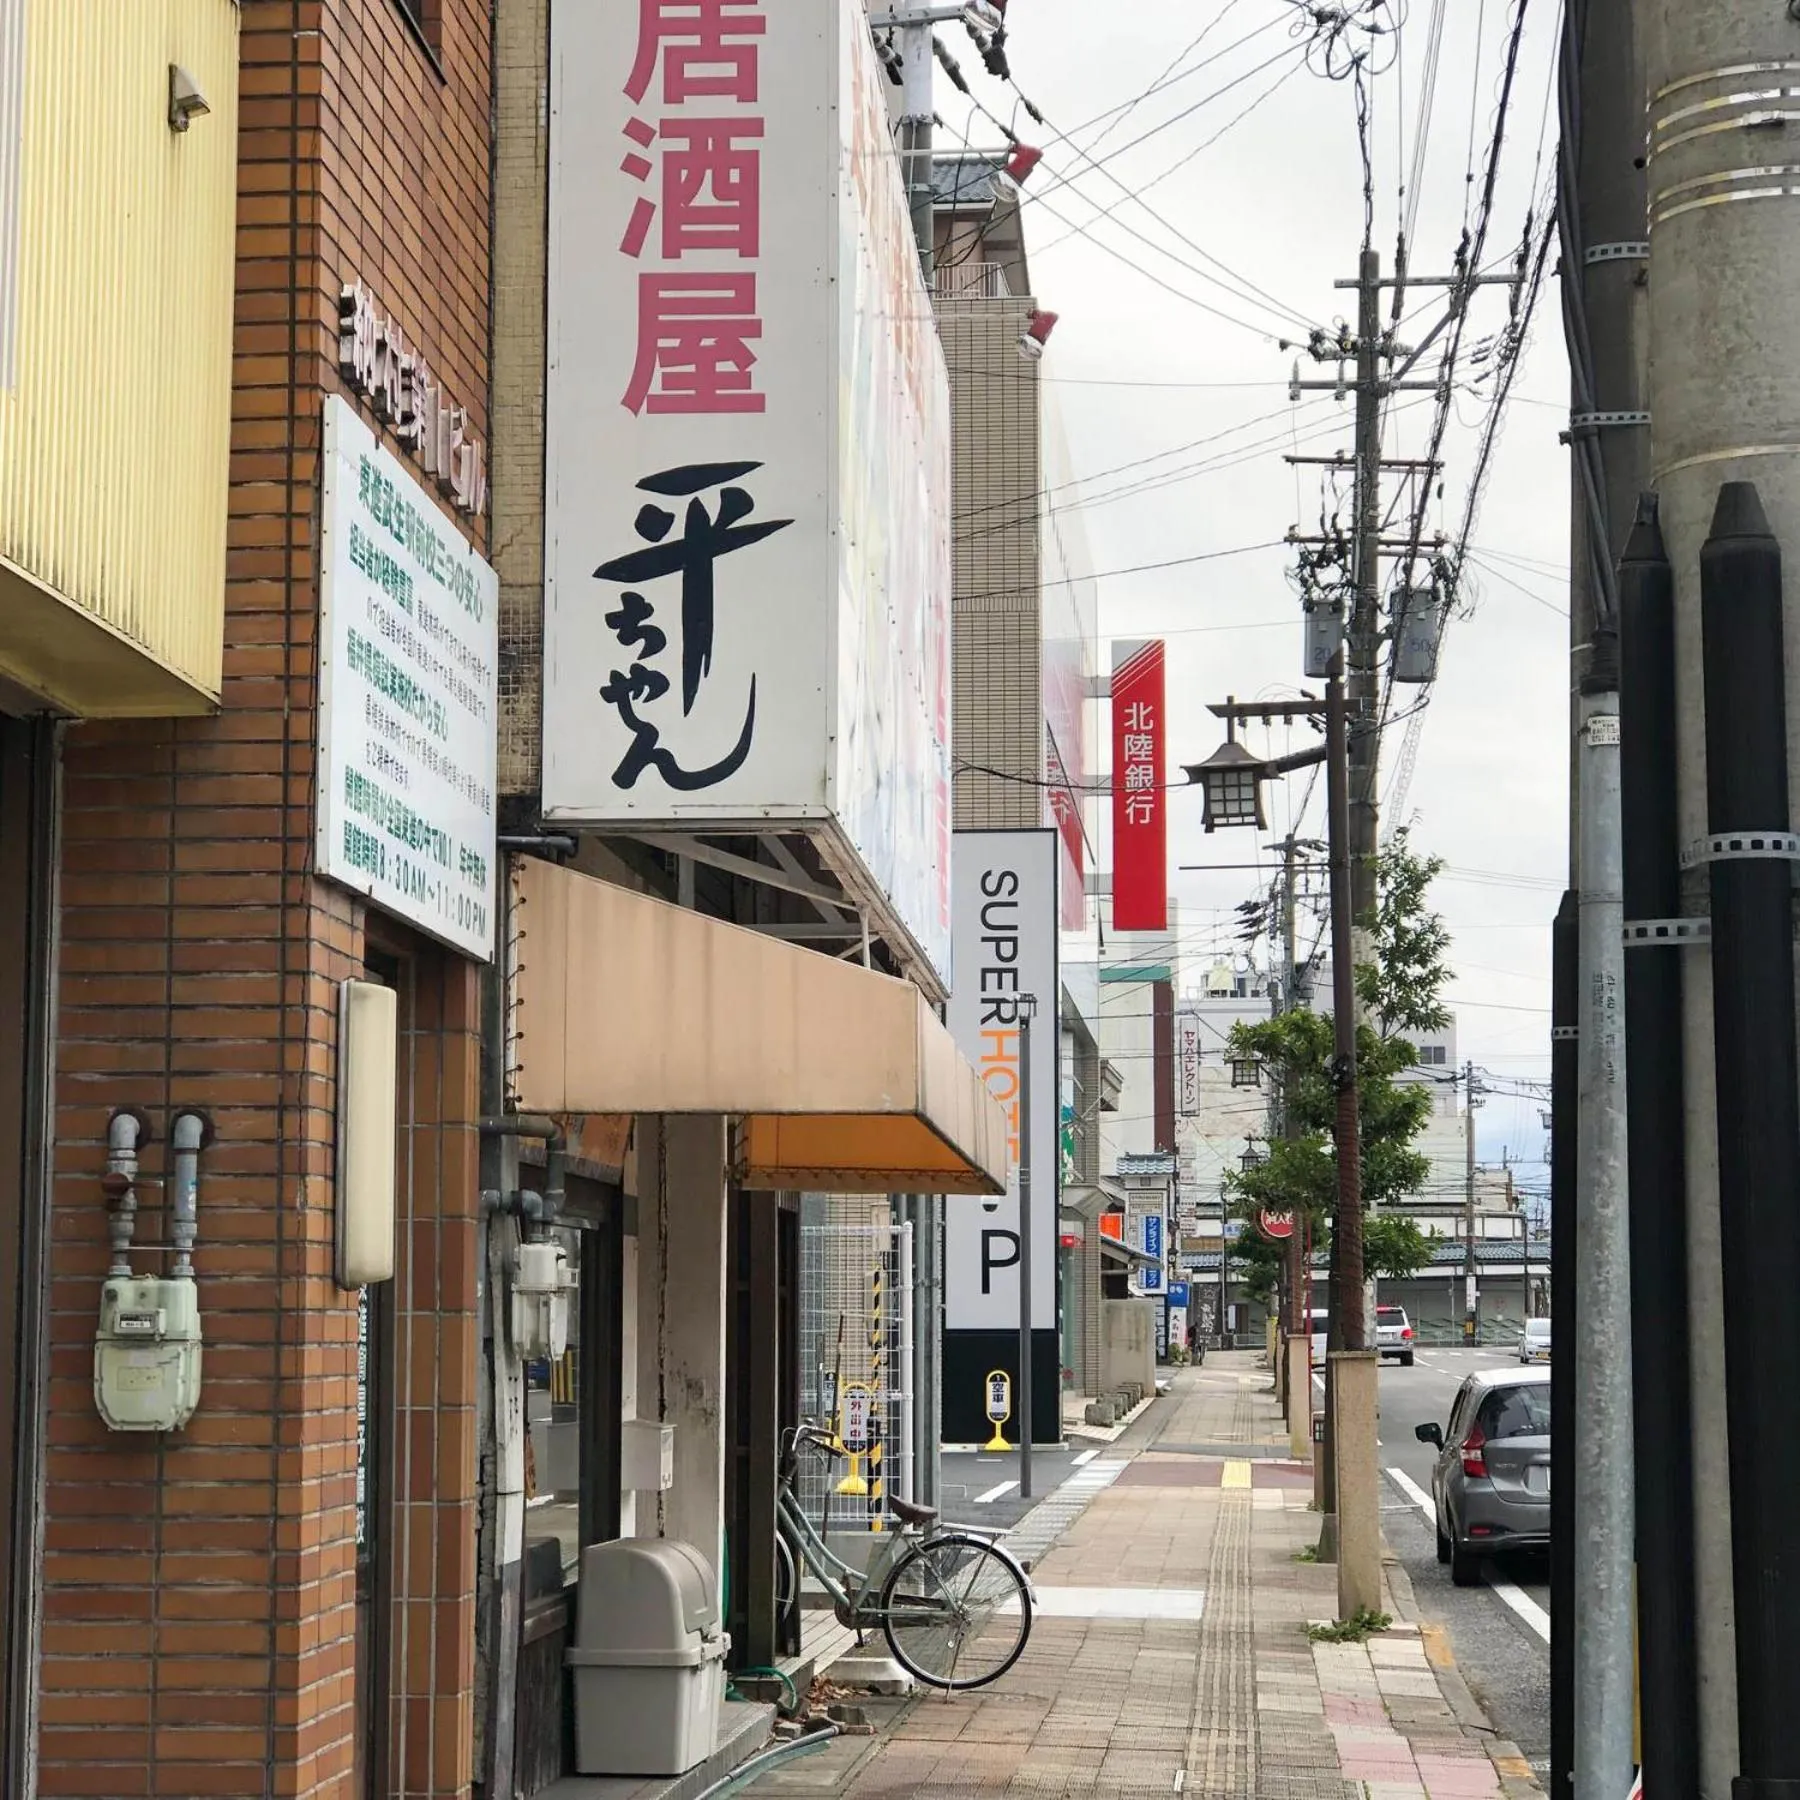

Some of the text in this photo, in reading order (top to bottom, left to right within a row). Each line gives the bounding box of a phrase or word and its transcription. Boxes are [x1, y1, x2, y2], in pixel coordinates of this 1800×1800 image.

[619, 0, 767, 417] 居酒屋
[592, 461, 796, 791] 平ちゃん
[1124, 701, 1155, 825] 北陸銀行
[980, 1229, 1021, 1294] P
